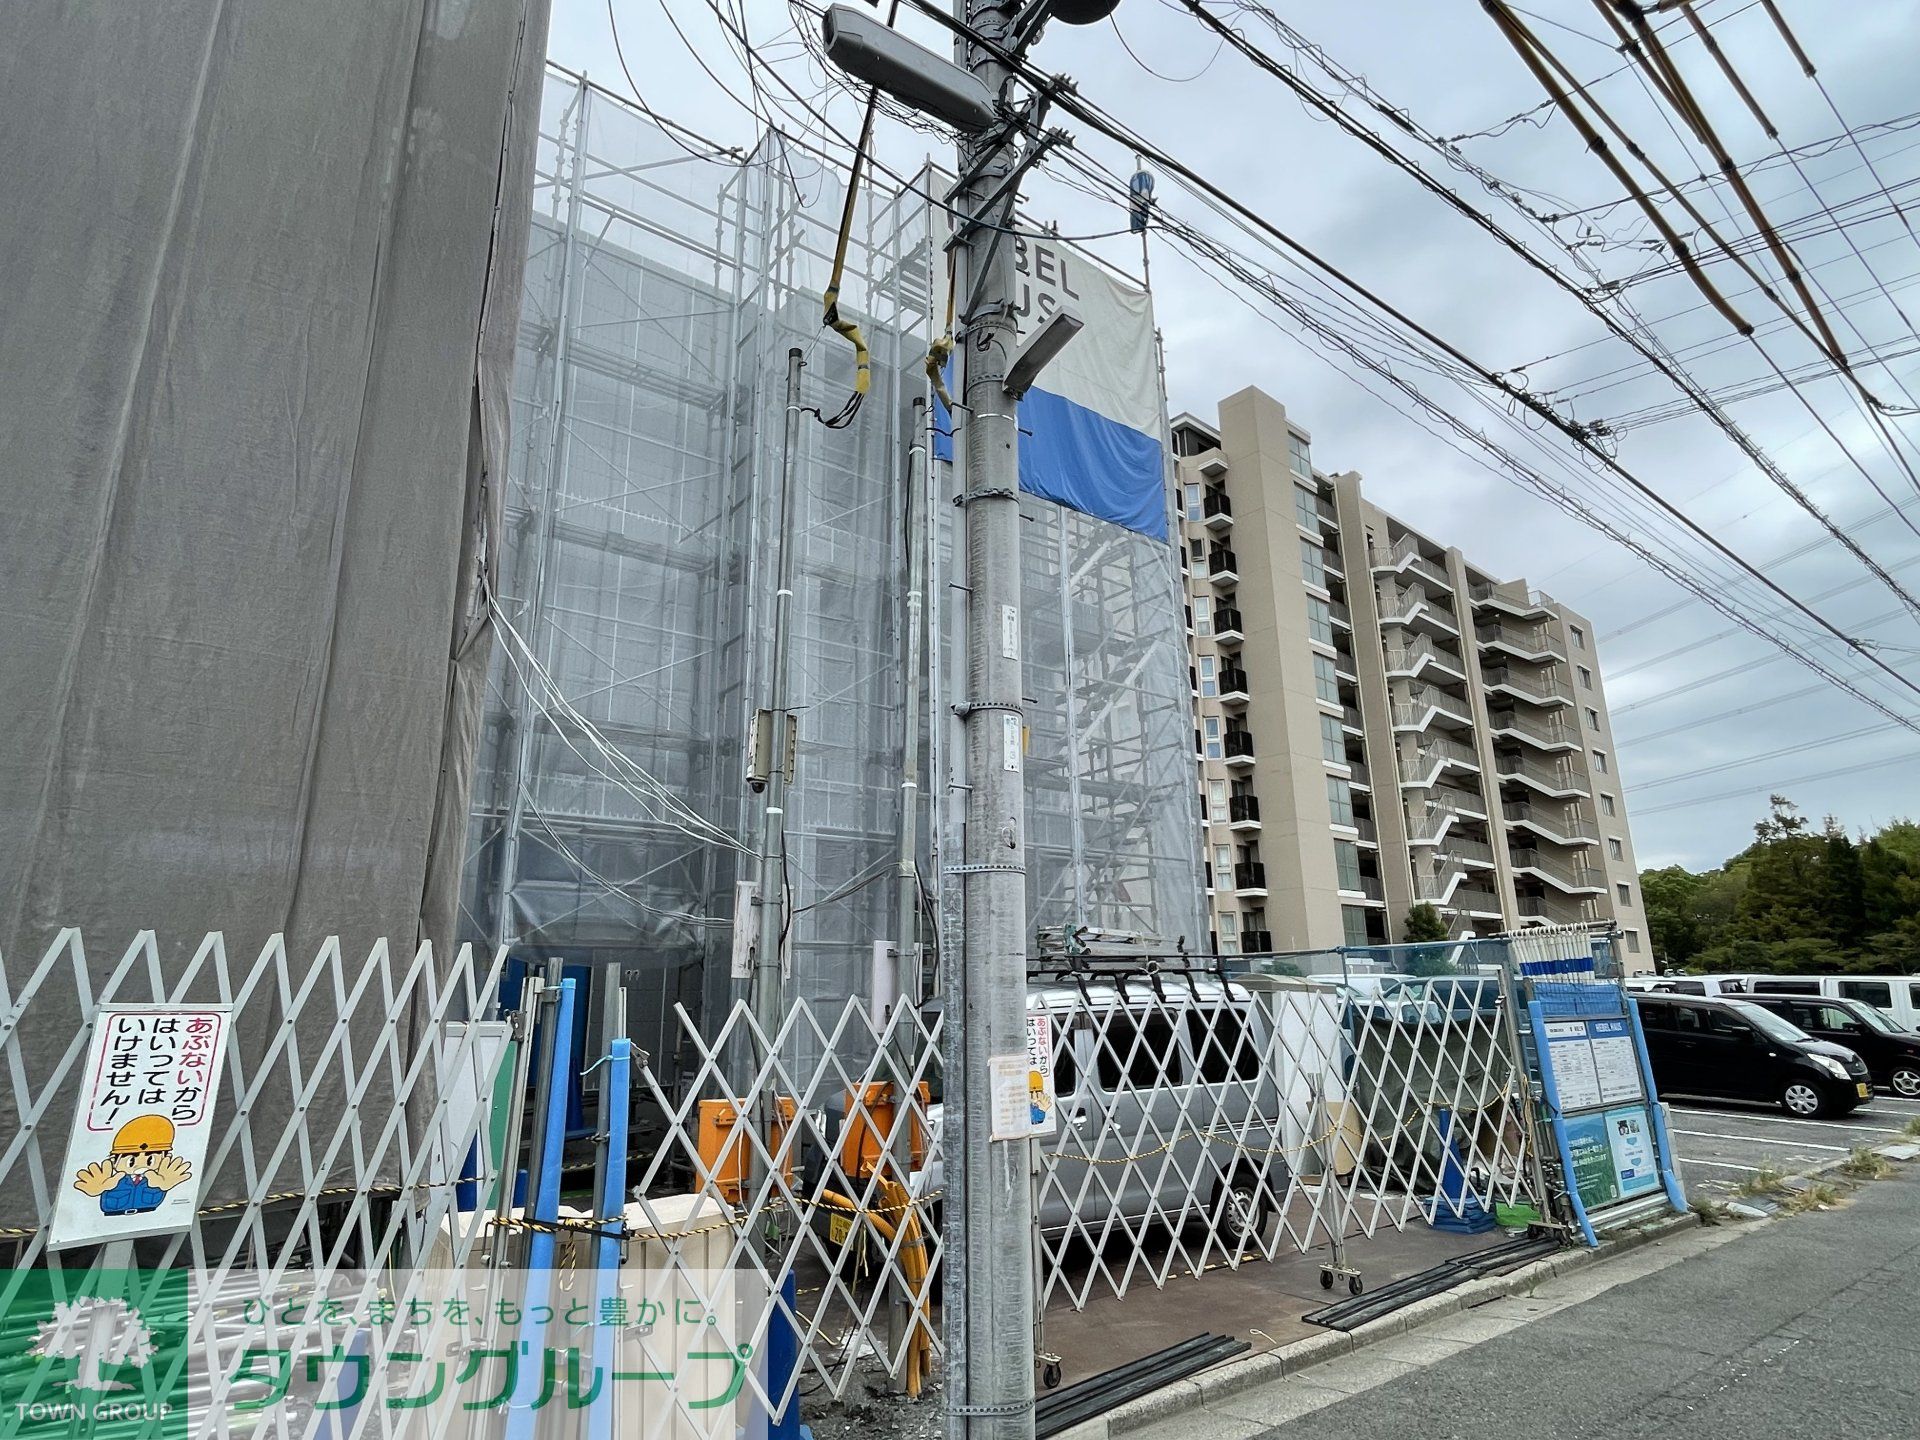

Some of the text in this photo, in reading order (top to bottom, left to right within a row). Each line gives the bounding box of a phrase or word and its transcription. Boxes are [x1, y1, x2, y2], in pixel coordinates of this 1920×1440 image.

[172, 1017, 213, 1121] あぶないから
